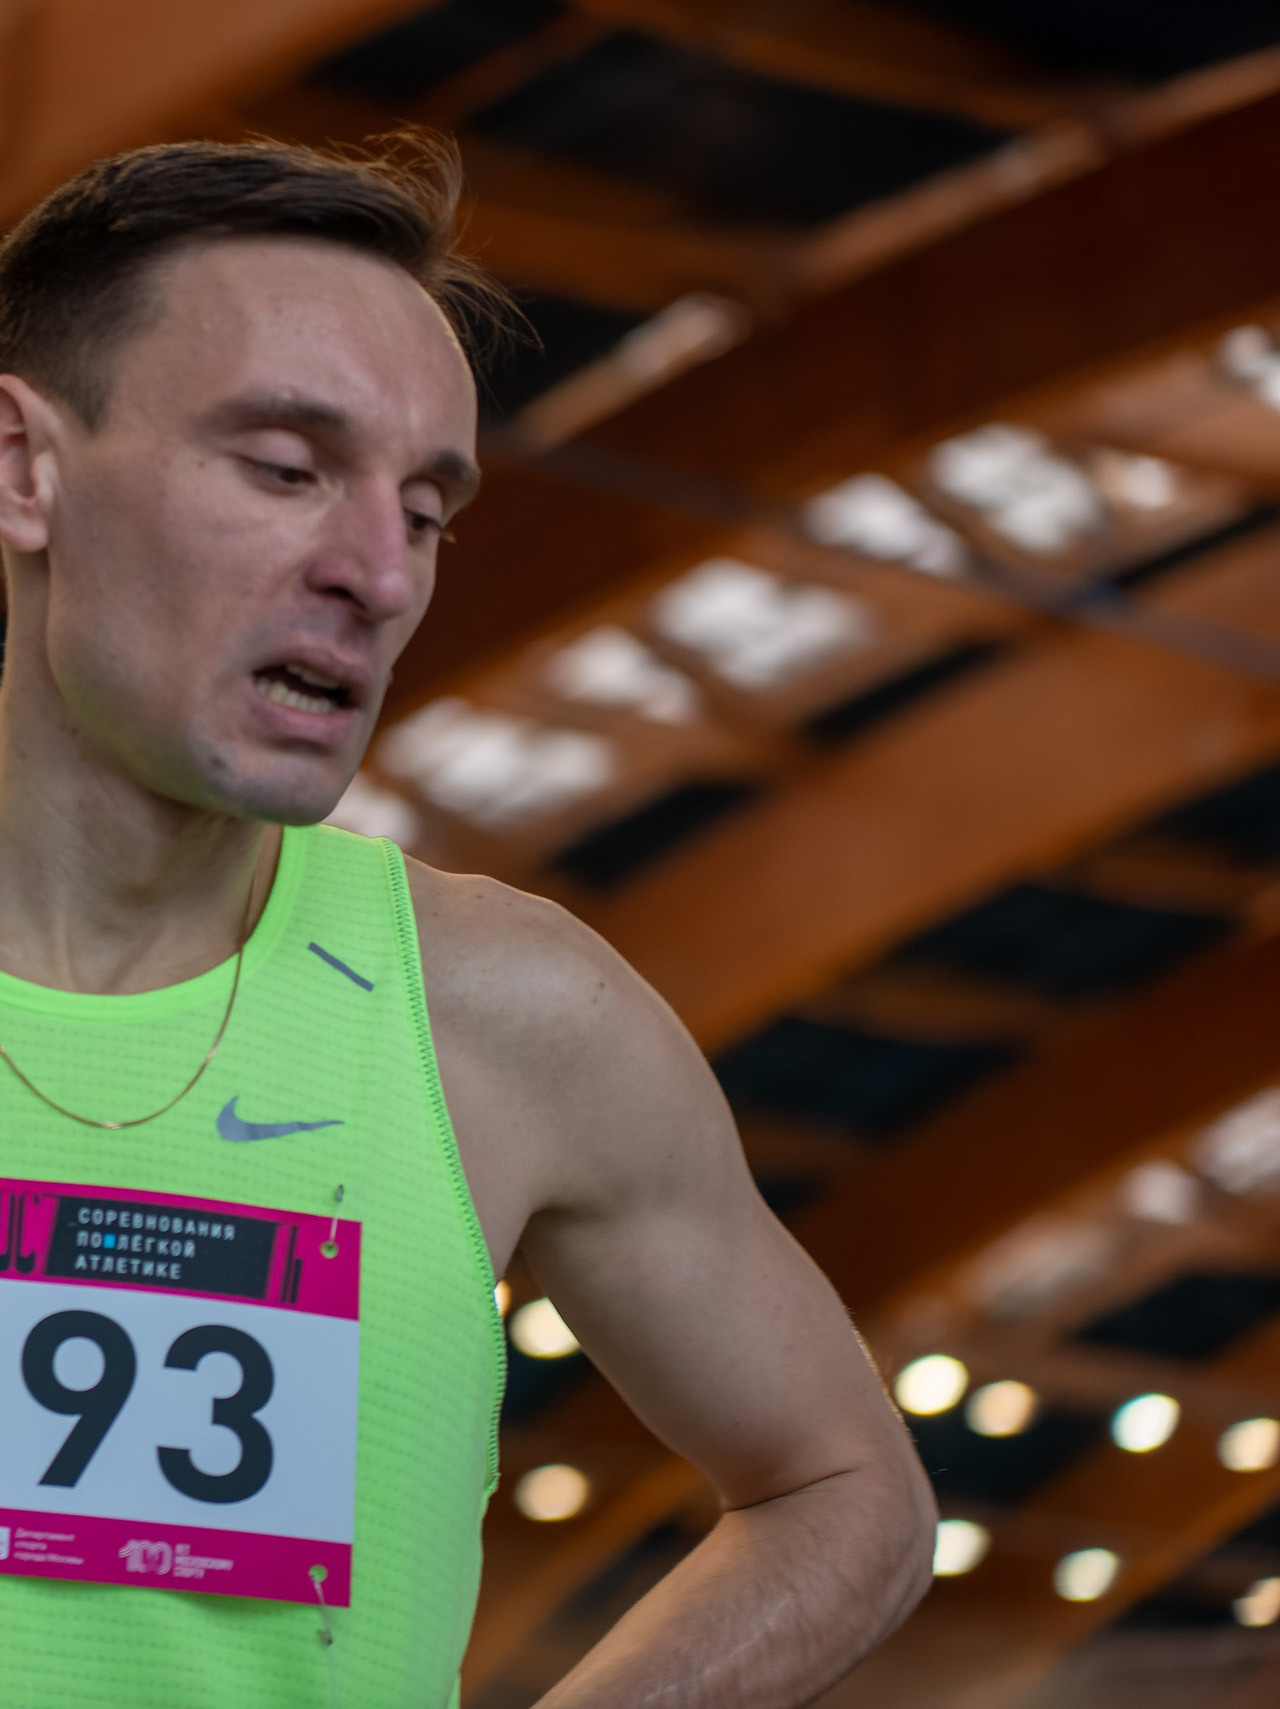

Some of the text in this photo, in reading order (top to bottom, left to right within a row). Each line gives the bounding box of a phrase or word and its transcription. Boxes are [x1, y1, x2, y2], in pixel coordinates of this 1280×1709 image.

[77, 1206, 236, 1241] СОРЕВНОВАНИЯ
[76, 1230, 102, 1249] ПО
[74, 1254, 182, 1280] АТЛЕТИКЕ
